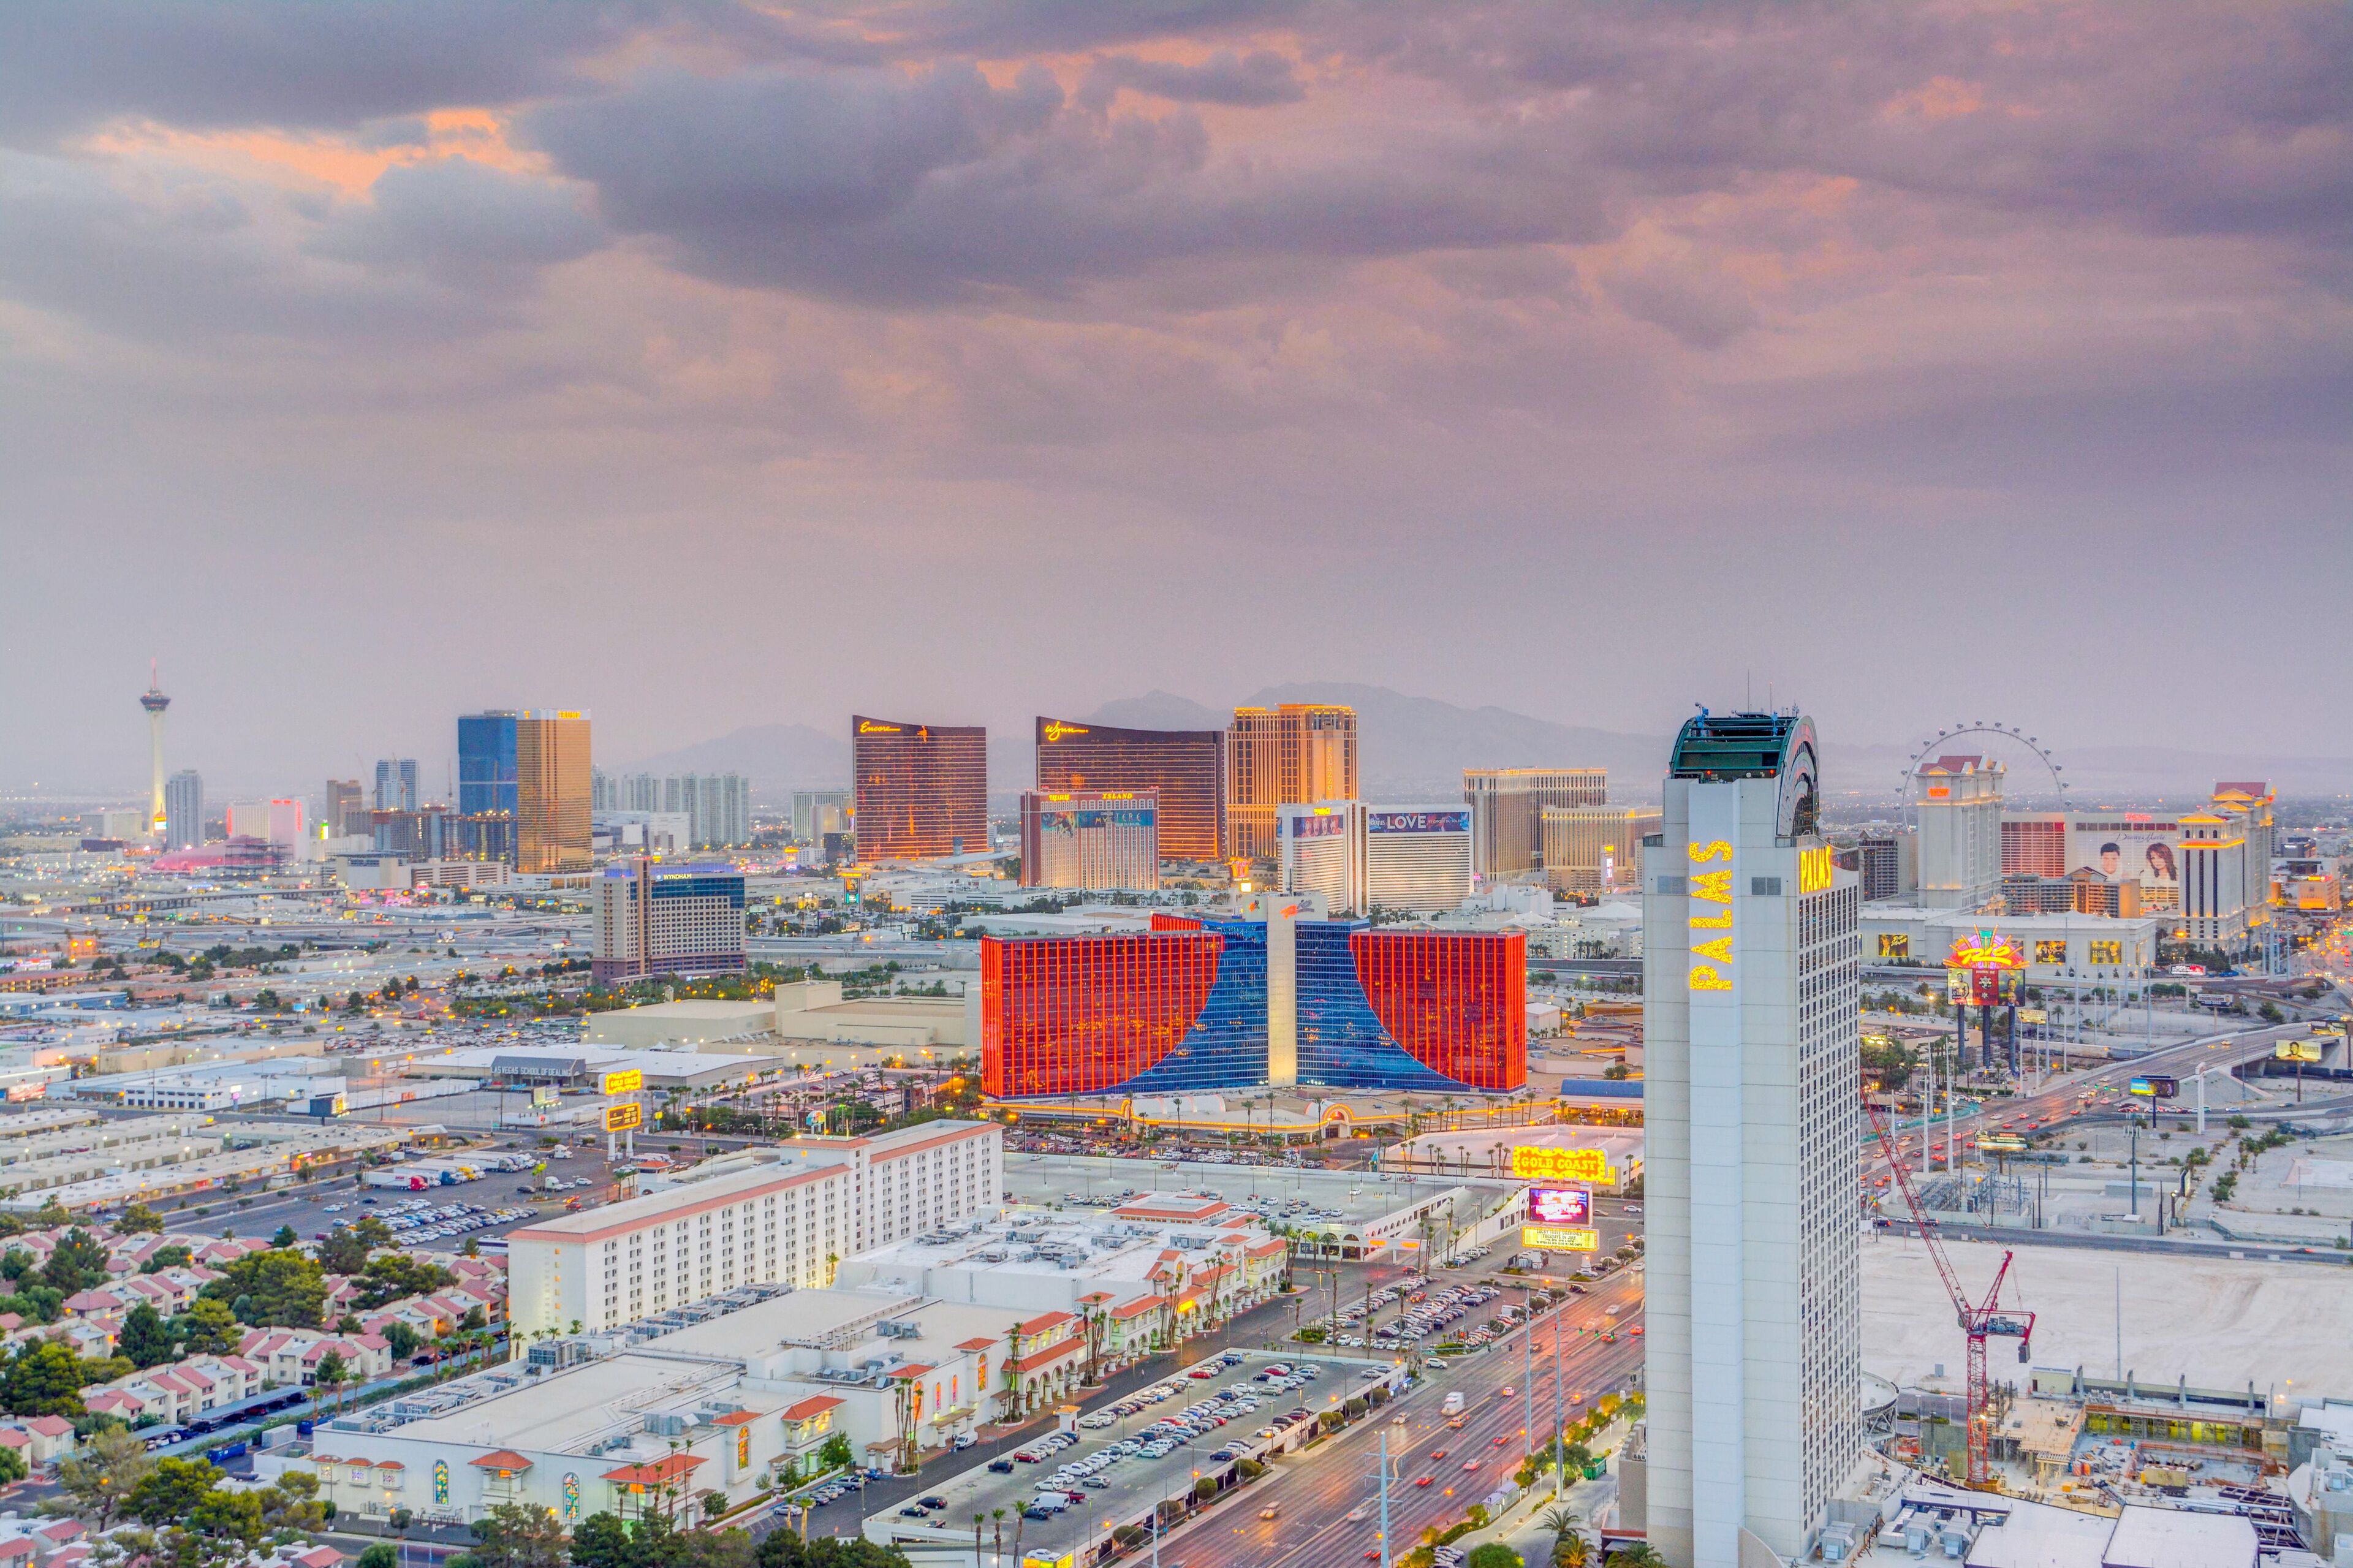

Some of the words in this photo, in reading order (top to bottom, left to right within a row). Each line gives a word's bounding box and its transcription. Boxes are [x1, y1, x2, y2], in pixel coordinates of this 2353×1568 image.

[558, 711, 581, 719] TRUMP
[860, 721, 901, 733] Encore
[1387, 815, 1427, 829] LOVE
[1800, 845, 1833, 895] PALMS
[1688, 839, 1733, 991] PALMS
[548, 1068, 572, 1077] DEALING
[1521, 1156, 1554, 1168] GOLD
[1557, 1159, 1596, 1170] COAST
